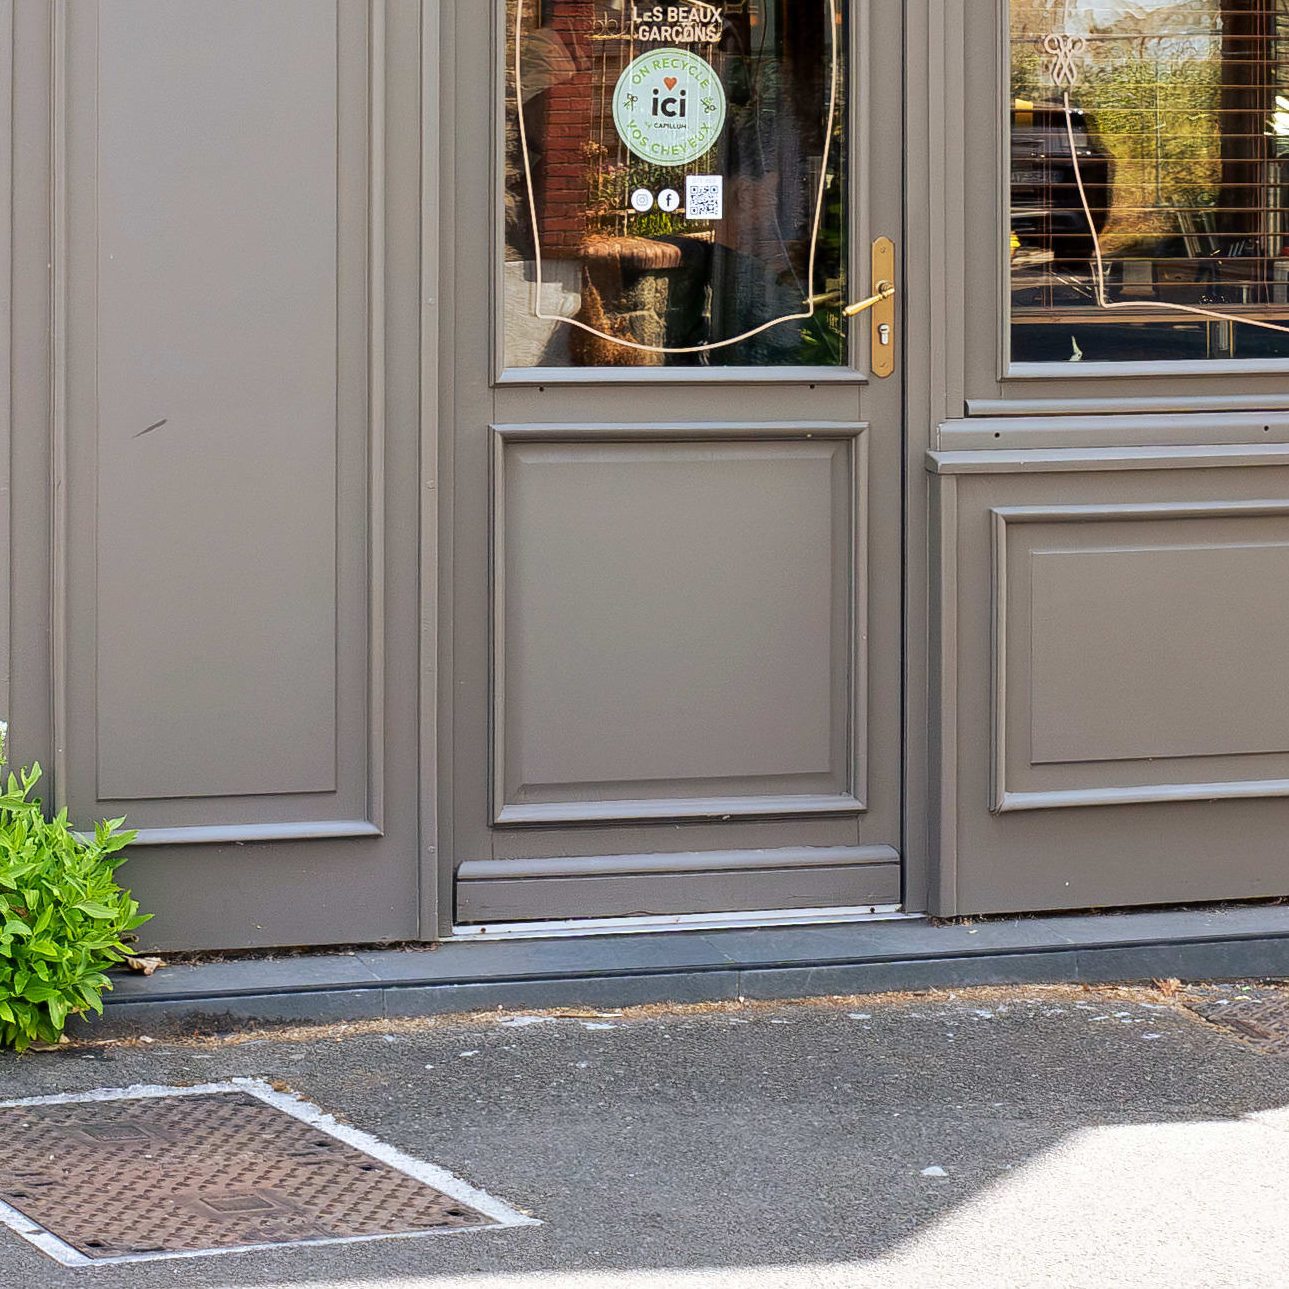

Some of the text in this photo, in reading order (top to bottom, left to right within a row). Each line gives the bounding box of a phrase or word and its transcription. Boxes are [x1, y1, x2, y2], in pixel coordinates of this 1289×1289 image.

[632, 6, 723, 24] LES BEAUX
[638, 25, 719, 45] GARÇONS
[631, 57, 710, 89] ON RECYCLE
[651, 88, 686, 118] ici
[626, 119, 711, 156] VOS CHEVEUX
